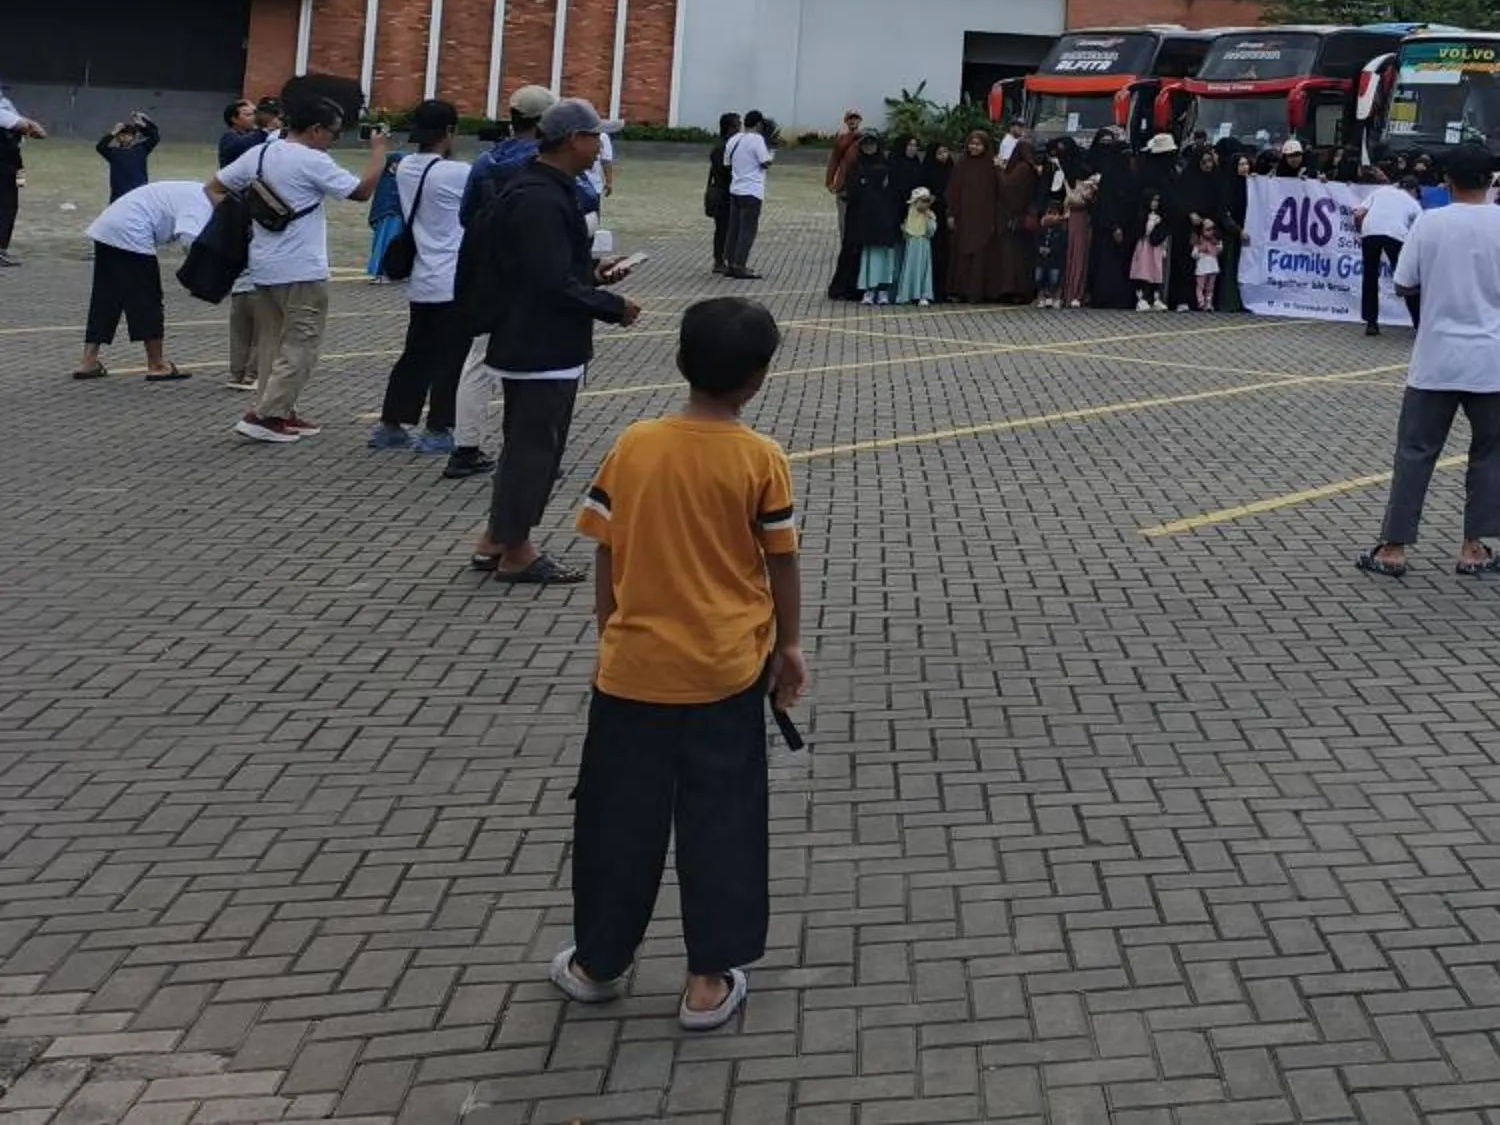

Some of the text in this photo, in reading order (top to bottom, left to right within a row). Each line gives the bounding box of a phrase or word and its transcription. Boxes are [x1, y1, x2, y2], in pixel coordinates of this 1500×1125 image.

[1439, 47, 1496, 60] VOLVO
[1270, 196, 1336, 247] AIS
[1338, 236, 1362, 250] Sch
[1267, 248, 1331, 279] Family
